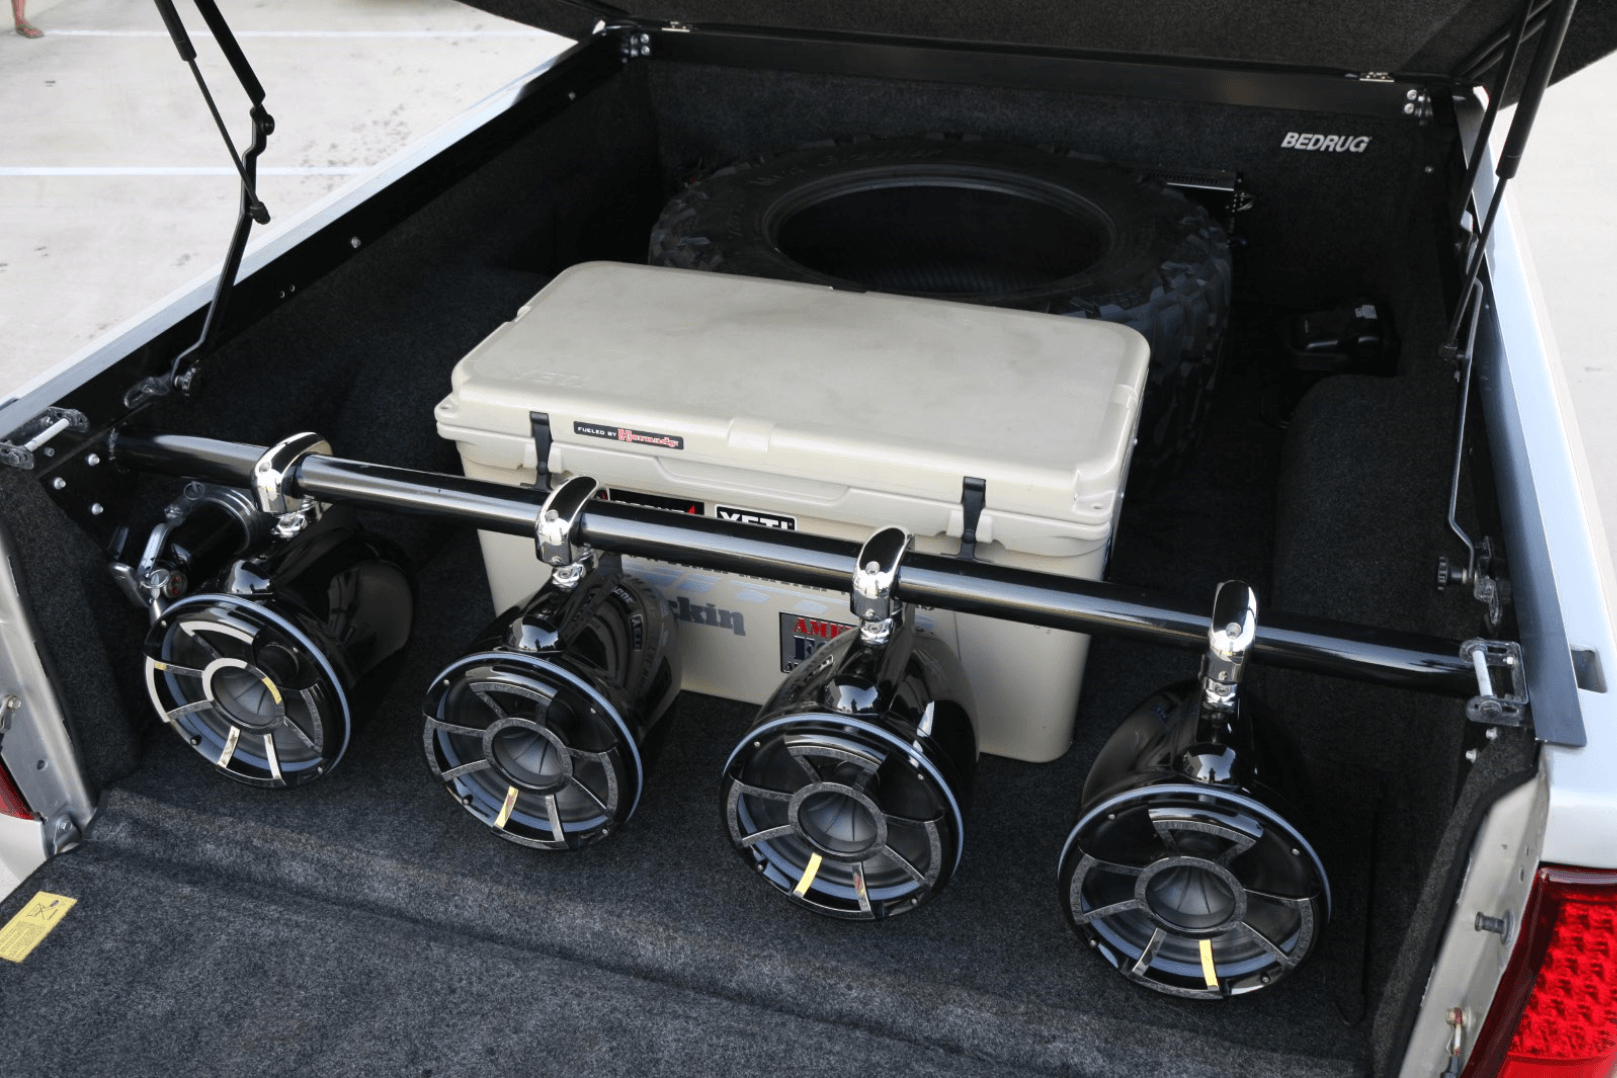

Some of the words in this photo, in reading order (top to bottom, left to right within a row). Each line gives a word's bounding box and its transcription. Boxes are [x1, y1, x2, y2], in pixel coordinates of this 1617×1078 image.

[1281, 132, 1369, 152] BEDRUG
[577, 426, 605, 435] FUELED
[617, 428, 679, 448] Hornady
[794, 617, 852, 640] AME
